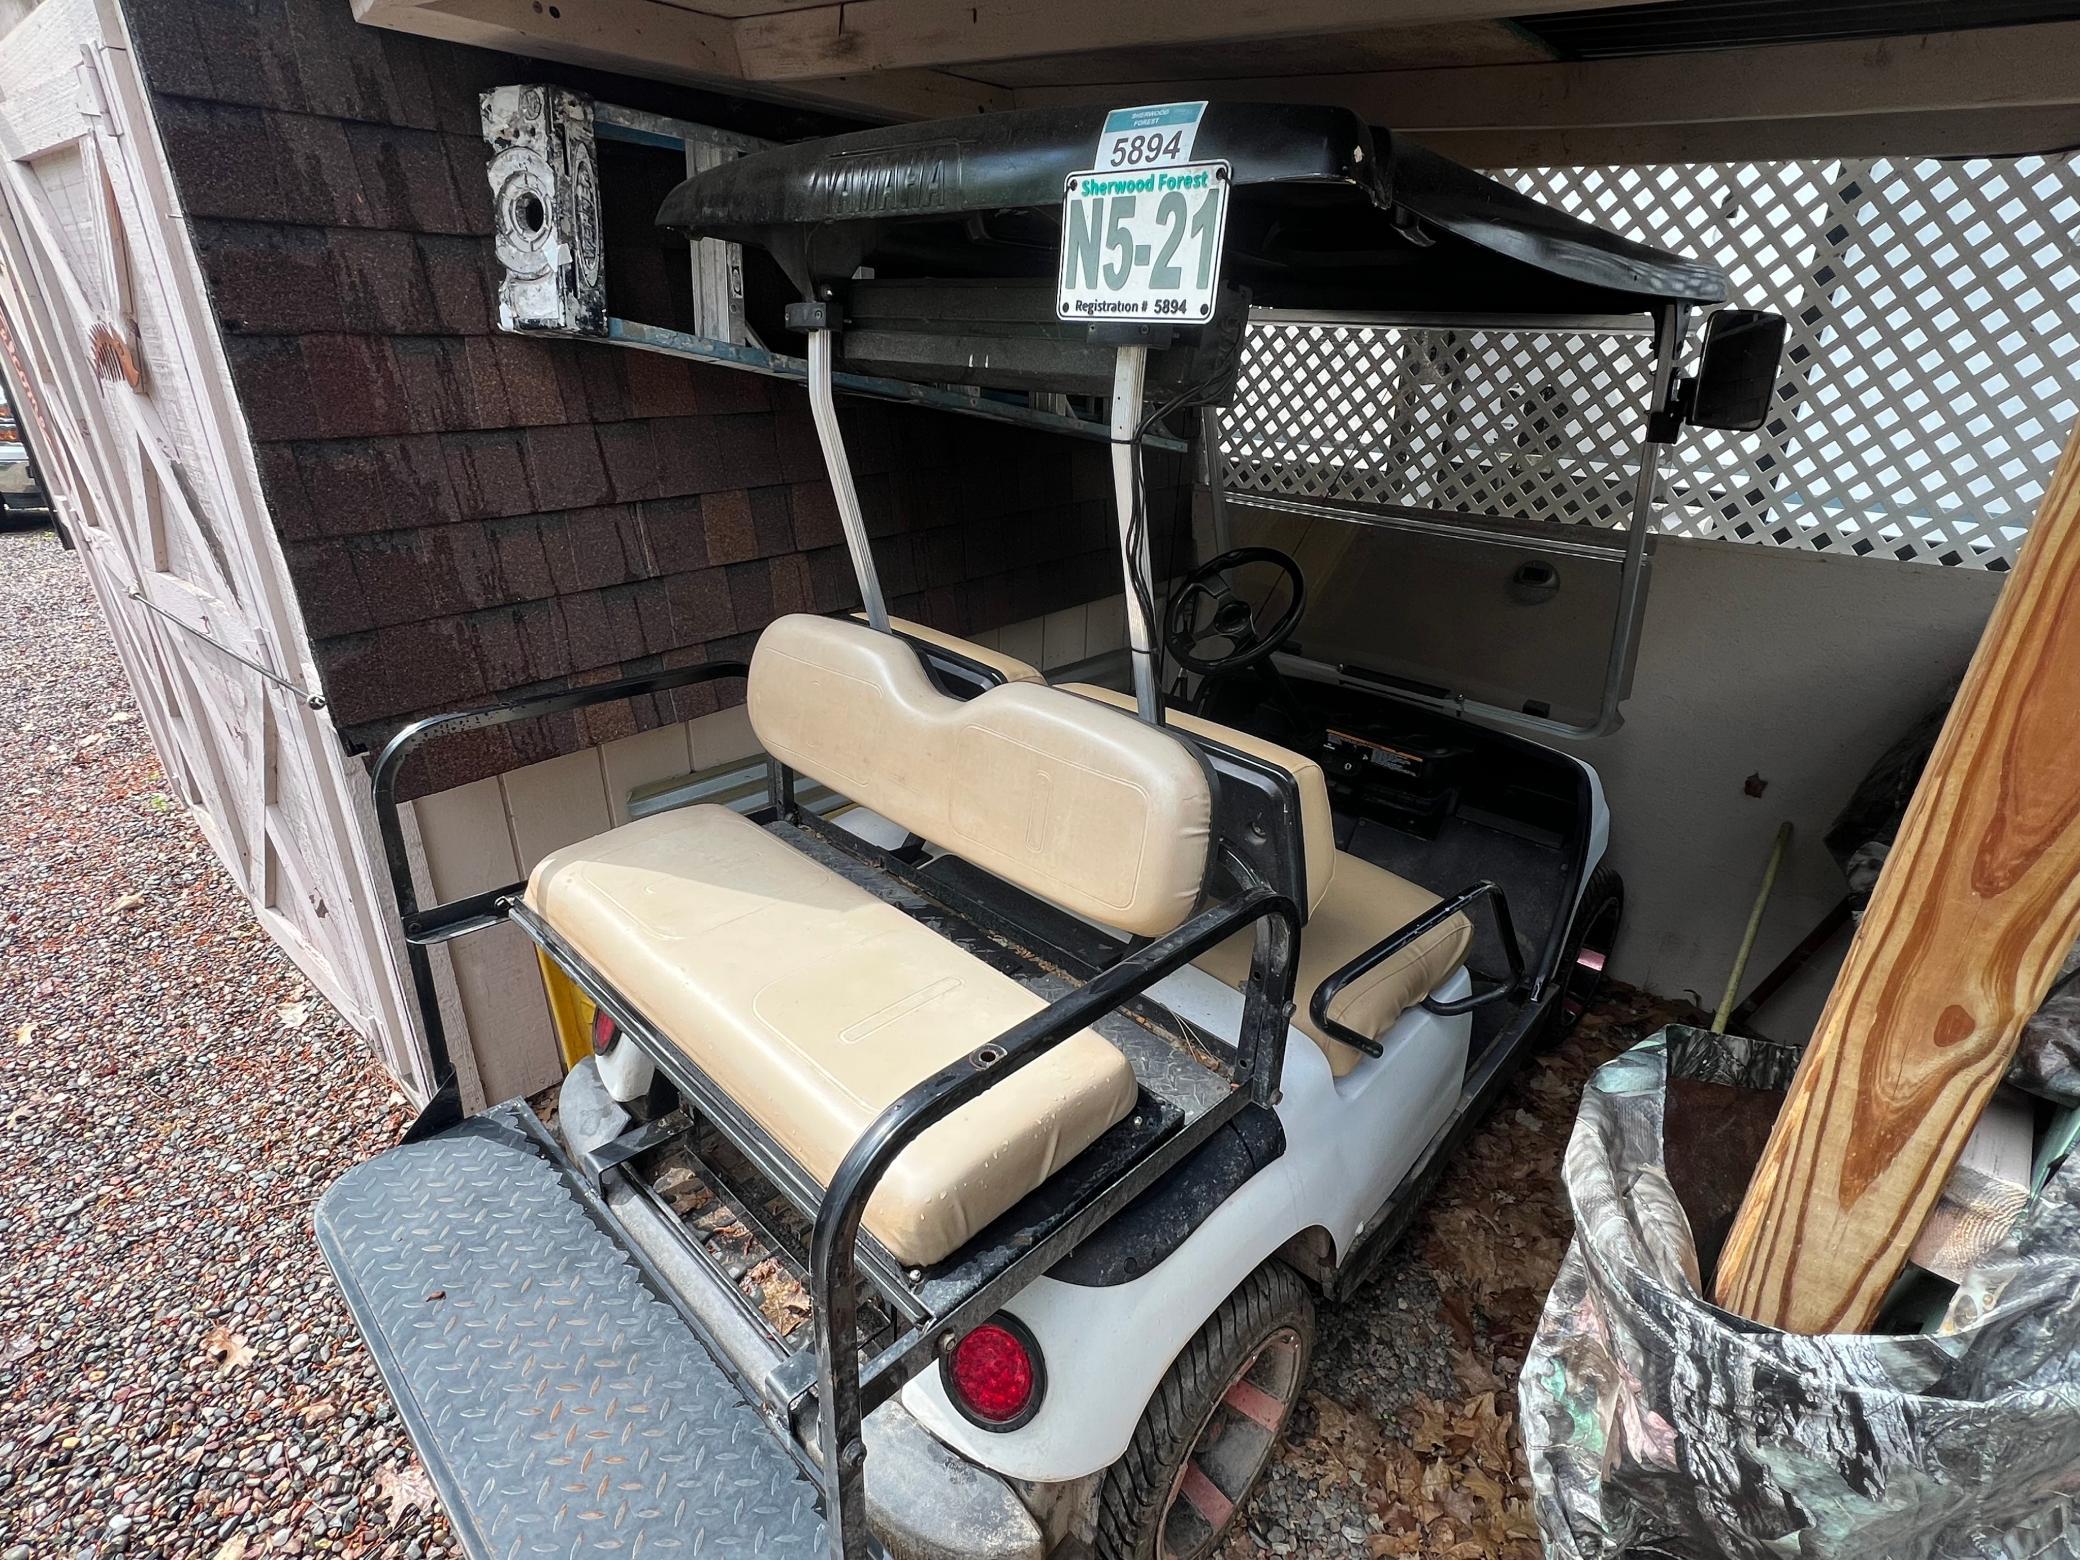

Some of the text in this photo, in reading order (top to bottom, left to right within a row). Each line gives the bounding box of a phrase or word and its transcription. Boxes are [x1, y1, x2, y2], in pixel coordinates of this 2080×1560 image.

[1110, 130, 1182, 167] 5894
[1081, 170, 1209, 197] Sherwood Forest
[1065, 188, 1219, 291] N5-21
[1075, 299, 1187, 315] Registration # 5894
